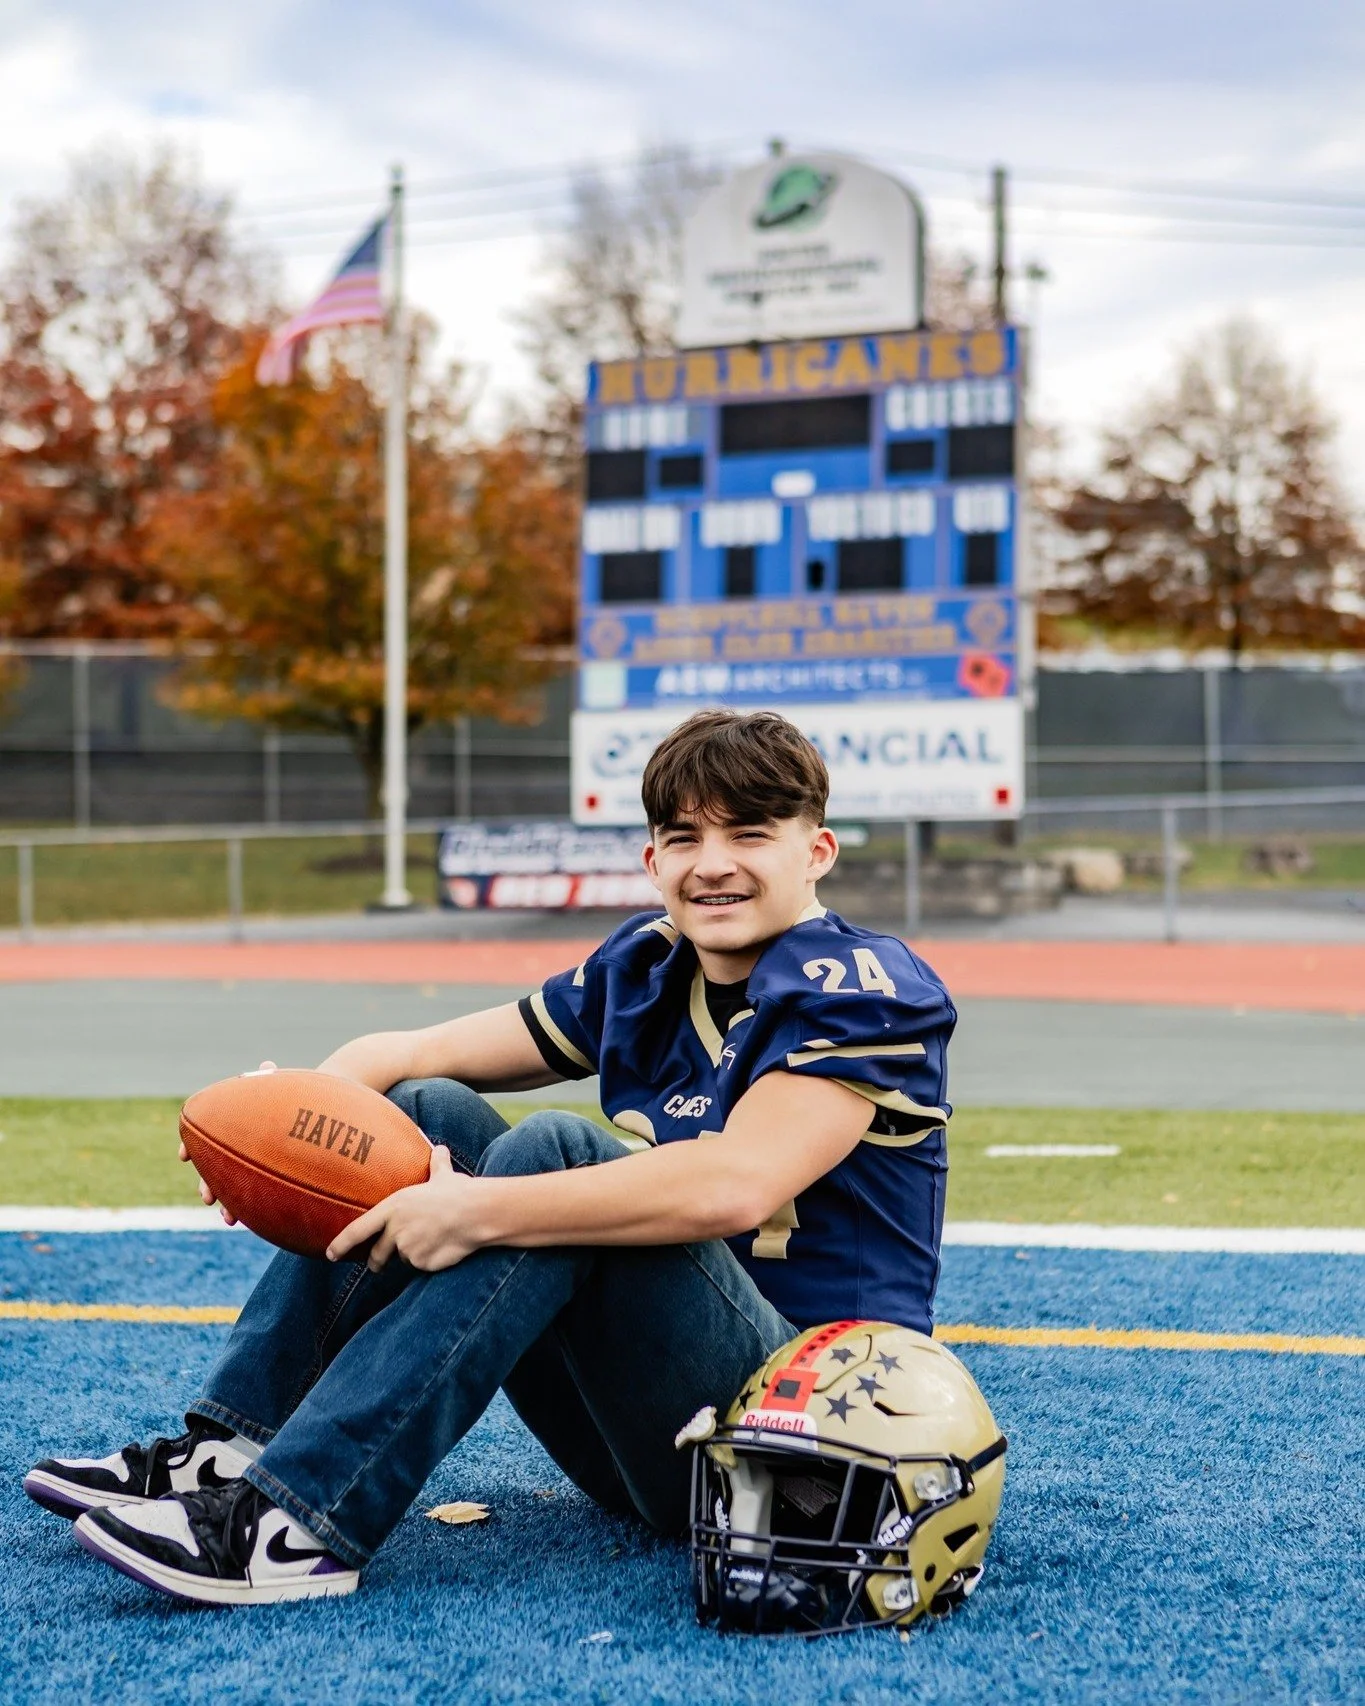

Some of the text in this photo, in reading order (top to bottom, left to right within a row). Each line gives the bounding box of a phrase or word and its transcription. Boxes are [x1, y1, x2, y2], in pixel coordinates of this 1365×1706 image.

[600, 331, 1004, 400] HURRICANES
[802, 947, 897, 999] 24
[288, 1107, 375, 1166] HAVEN
[744, 1414, 805, 1433] Riddell
